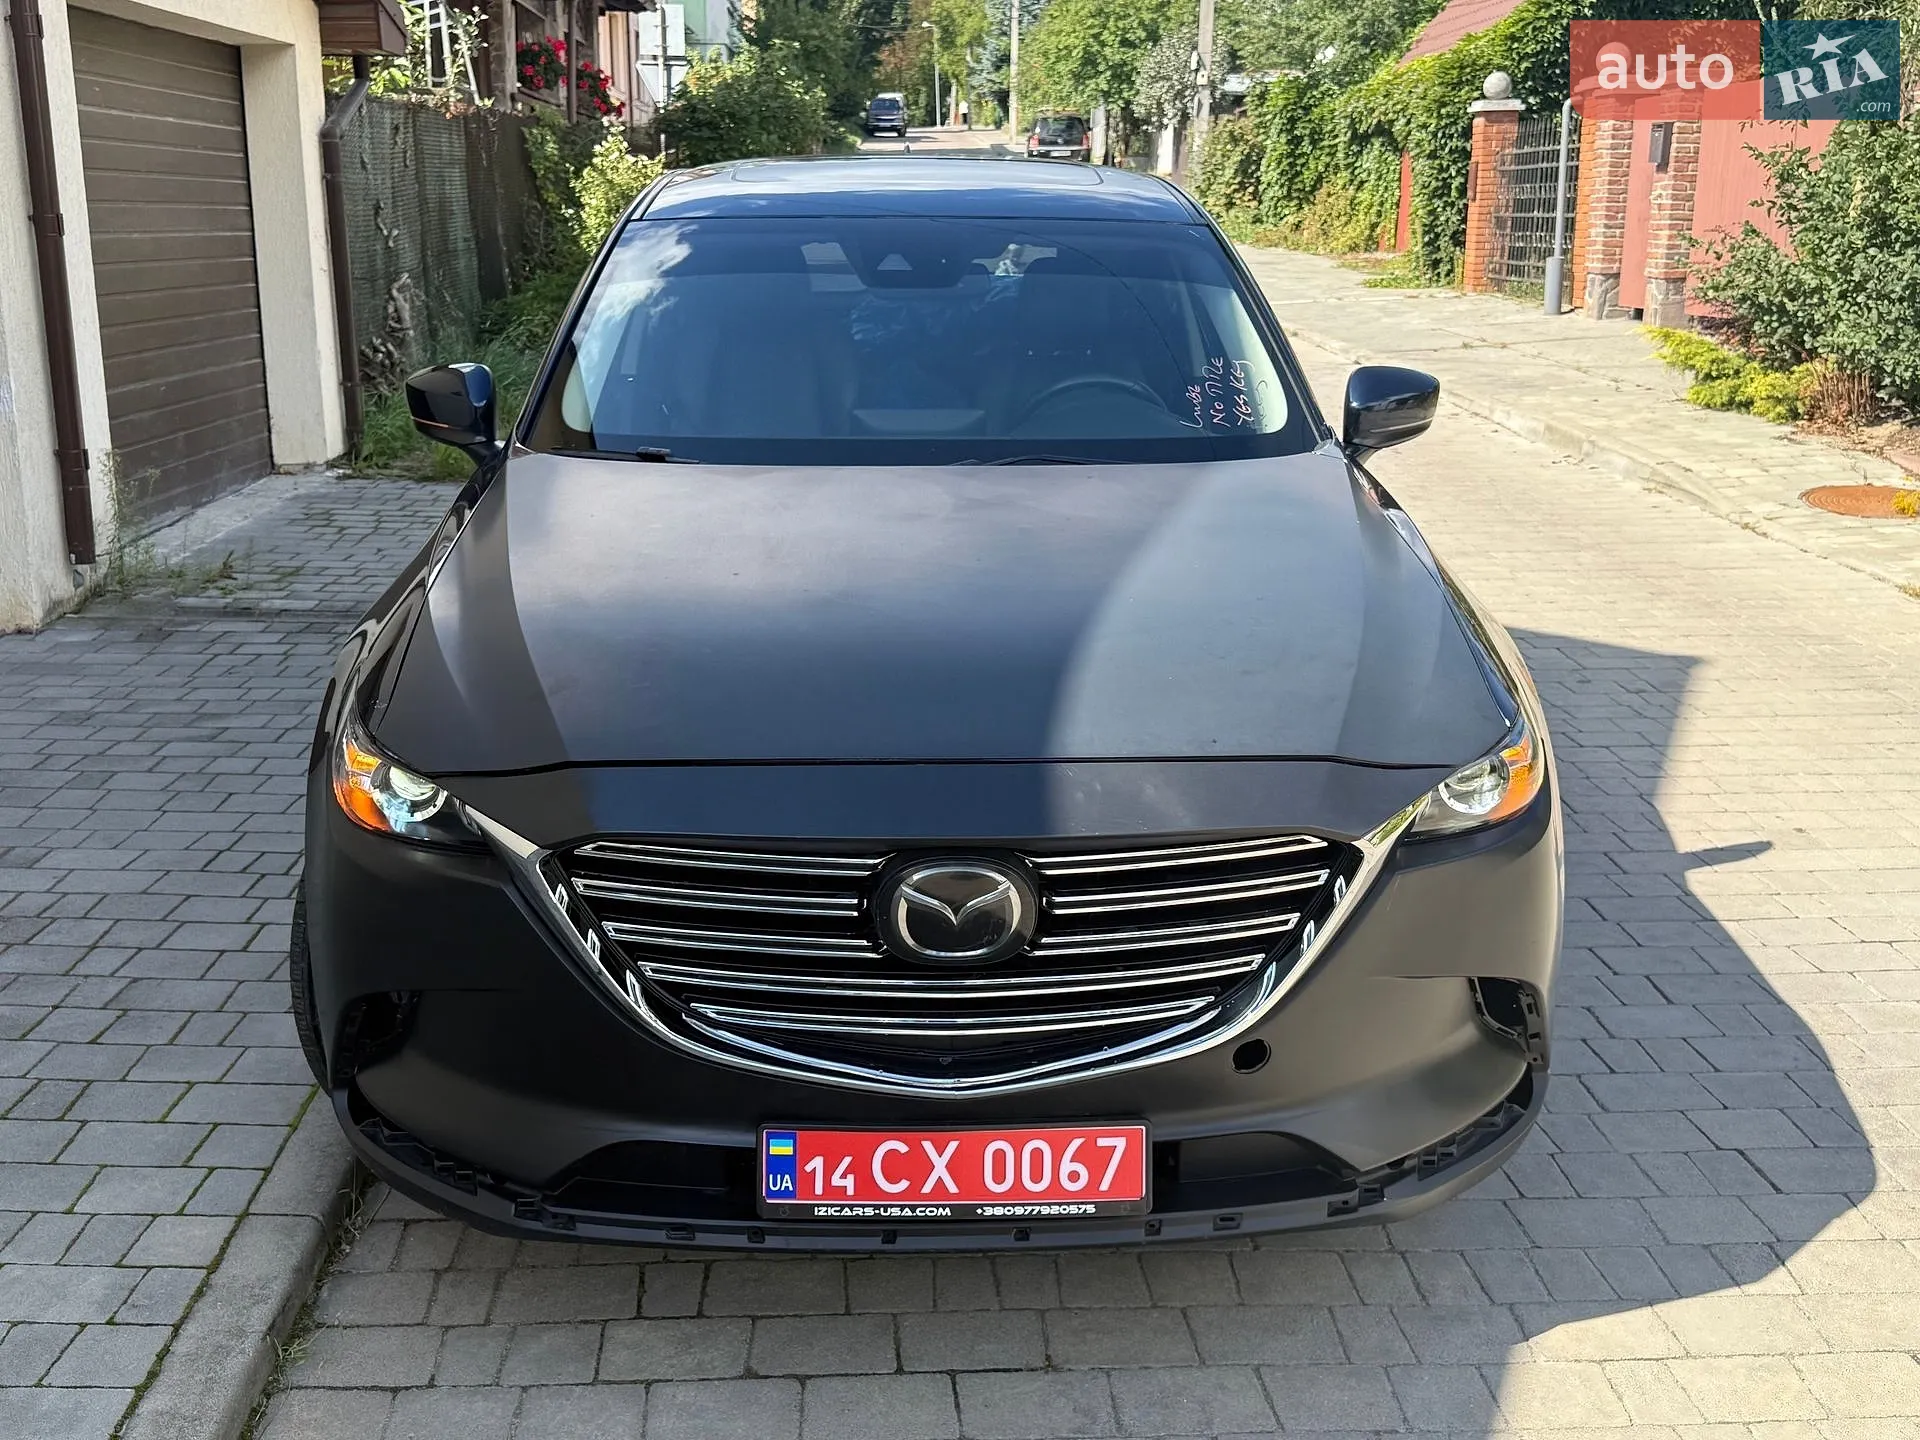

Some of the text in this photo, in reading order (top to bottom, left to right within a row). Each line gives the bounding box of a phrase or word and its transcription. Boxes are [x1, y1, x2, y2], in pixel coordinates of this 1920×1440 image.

[803, 1137, 1127, 1196] 14 CX 0067
[769, 1174, 794, 1191] UA
[814, 1204, 1097, 1217] IZICARS-USA.COM +380977920575
